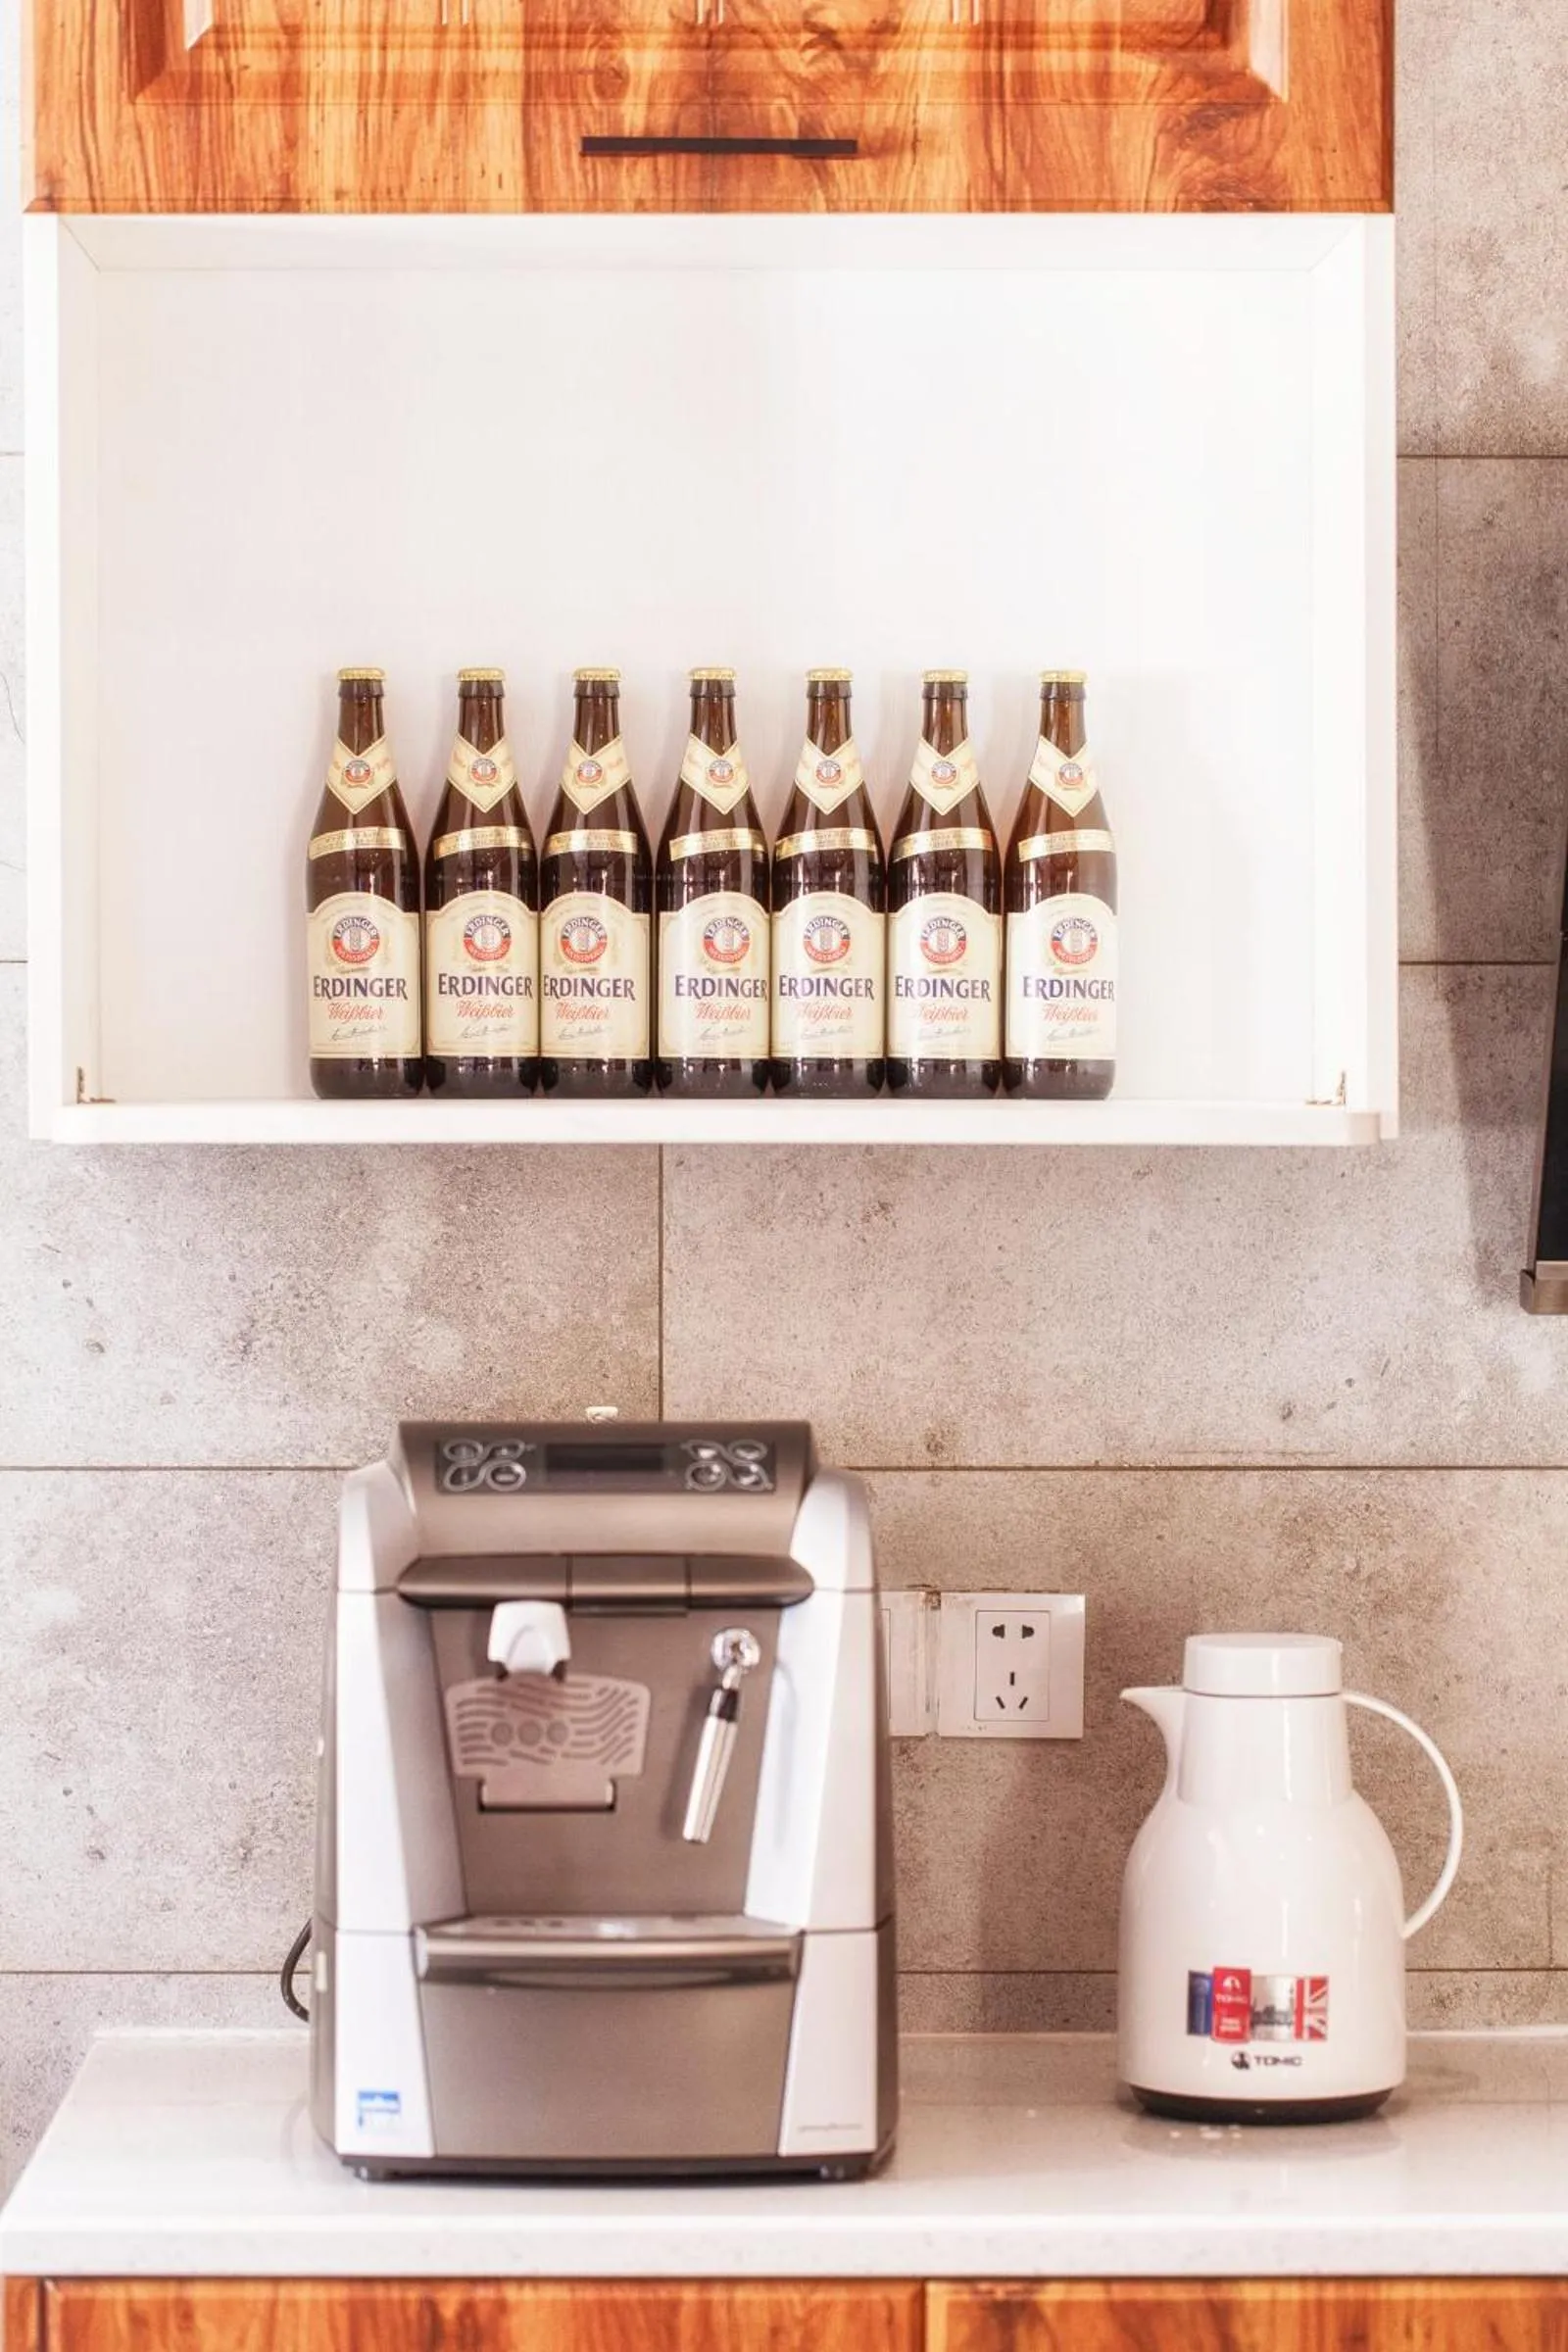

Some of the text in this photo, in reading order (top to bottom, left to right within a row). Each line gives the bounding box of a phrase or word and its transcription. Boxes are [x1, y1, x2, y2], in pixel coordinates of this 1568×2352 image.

[313, 975, 409, 1001] ERDINGER
[438, 973, 533, 999] ERDINGER
[543, 974, 636, 1001] ERDINGER
[674, 975, 768, 1001] ERDINGER
[779, 975, 874, 1001] ERDINGER
[895, 975, 991, 1002] ERDINGER
[1022, 976, 1115, 1002] ERDINGER
